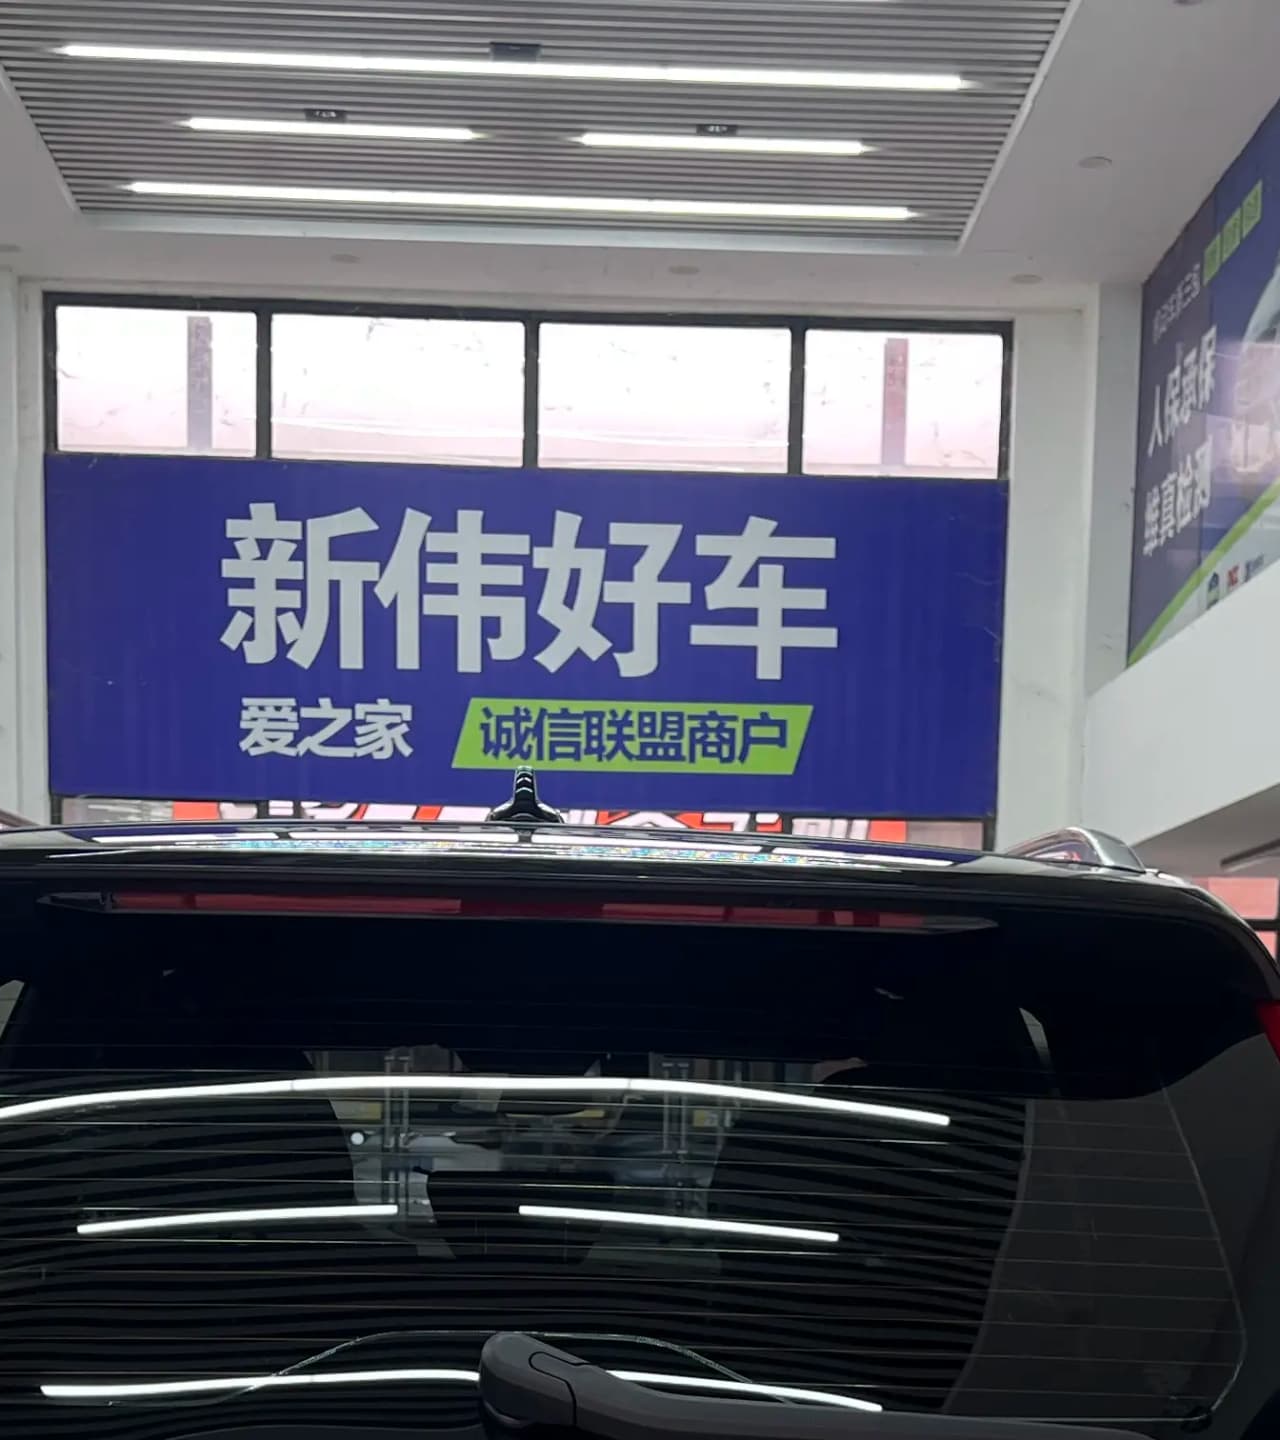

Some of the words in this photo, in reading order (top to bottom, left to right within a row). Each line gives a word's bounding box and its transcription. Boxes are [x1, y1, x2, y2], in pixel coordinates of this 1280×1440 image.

[219, 502, 839, 681] 新伟好车
[239, 697, 413, 759] 爱之家
[480, 706, 787, 764] 诚信联盟商户
